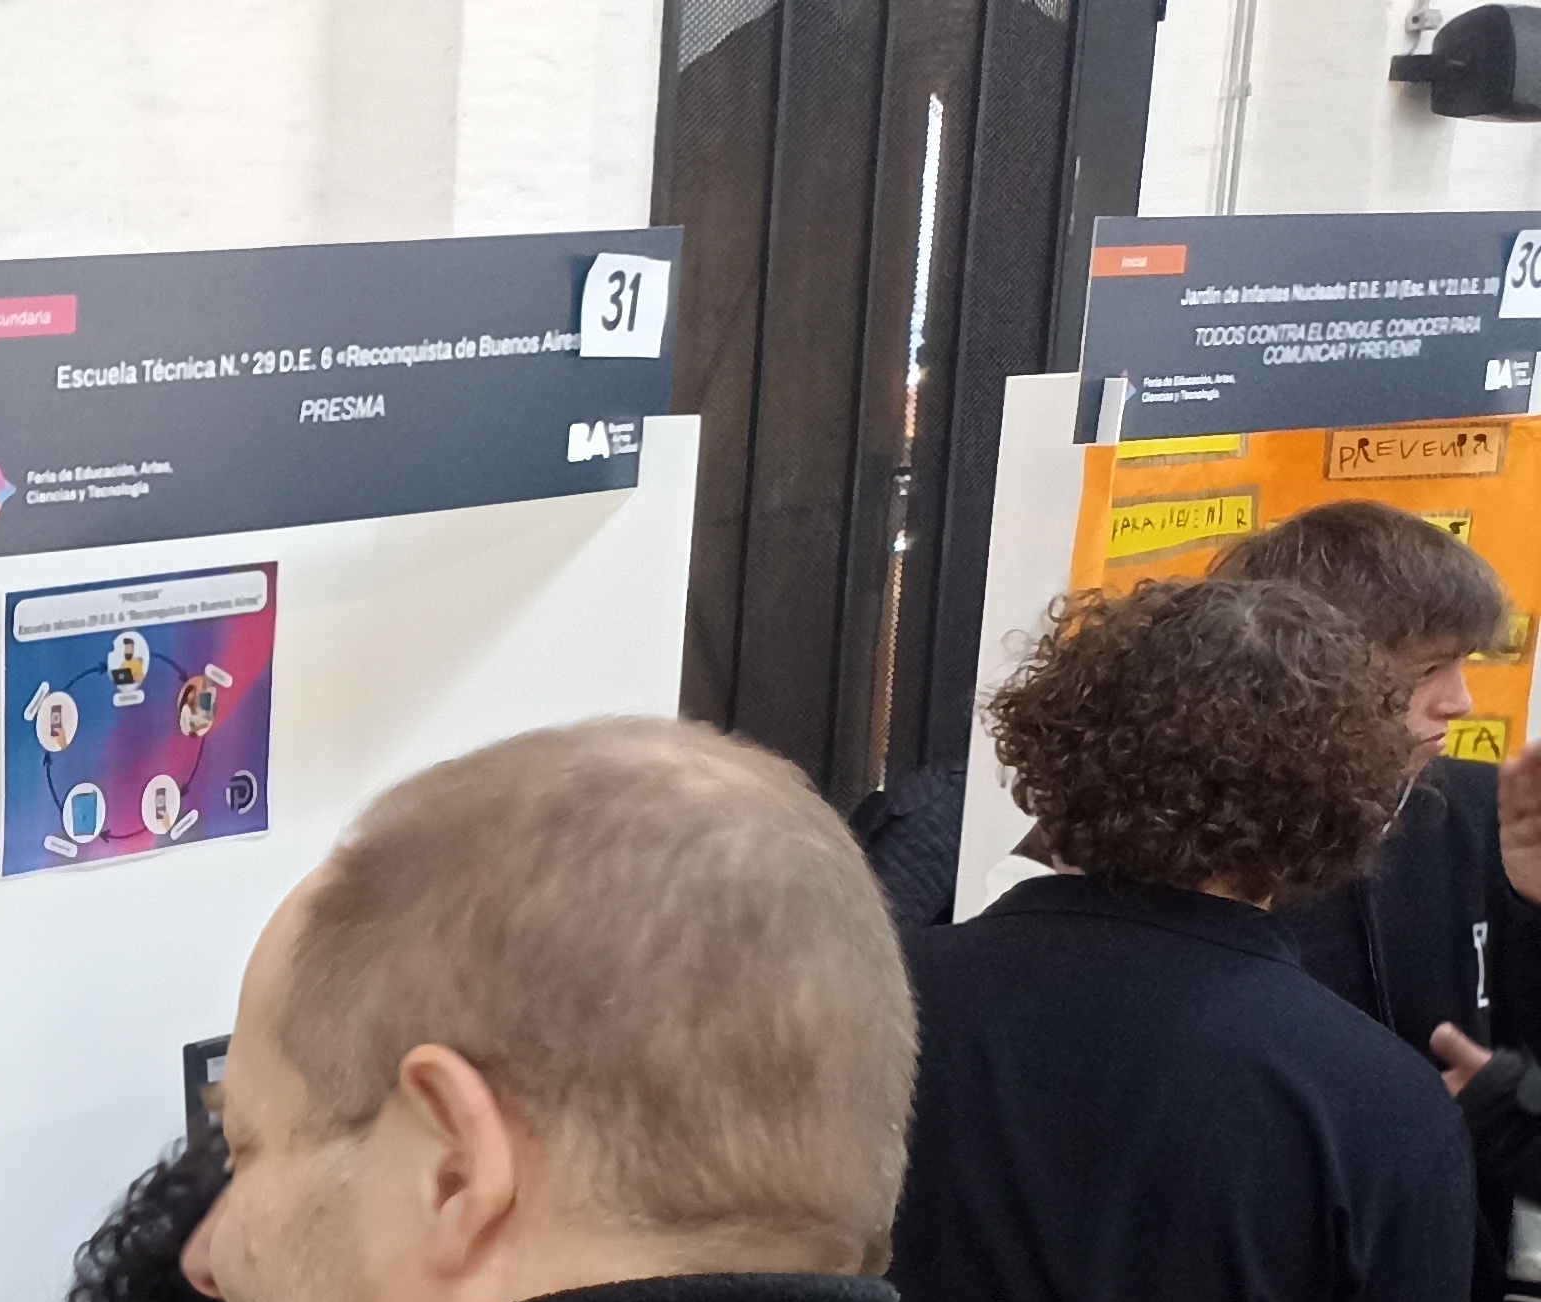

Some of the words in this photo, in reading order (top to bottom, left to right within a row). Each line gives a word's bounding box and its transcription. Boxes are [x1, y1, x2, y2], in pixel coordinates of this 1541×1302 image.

[601, 270, 641, 332] 31
[1195, 326, 1246, 346] TODOS
[1247, 323, 1306, 345] CONTRA
[1307, 322, 1323, 342] EL
[57, 361, 137, 389] Escuela
[141, 356, 217, 383] Técnica
[252, 350, 276, 376] 29
[279, 347, 317, 373] D.E.
[321, 346, 333, 370] 6
[455, 336, 476, 359] de
[479, 334, 540, 357] Buenos
[1263, 342, 1347, 365] COMUNICAR
[299, 394, 385, 424] PRESMA
[567, 420, 610, 462] BA
